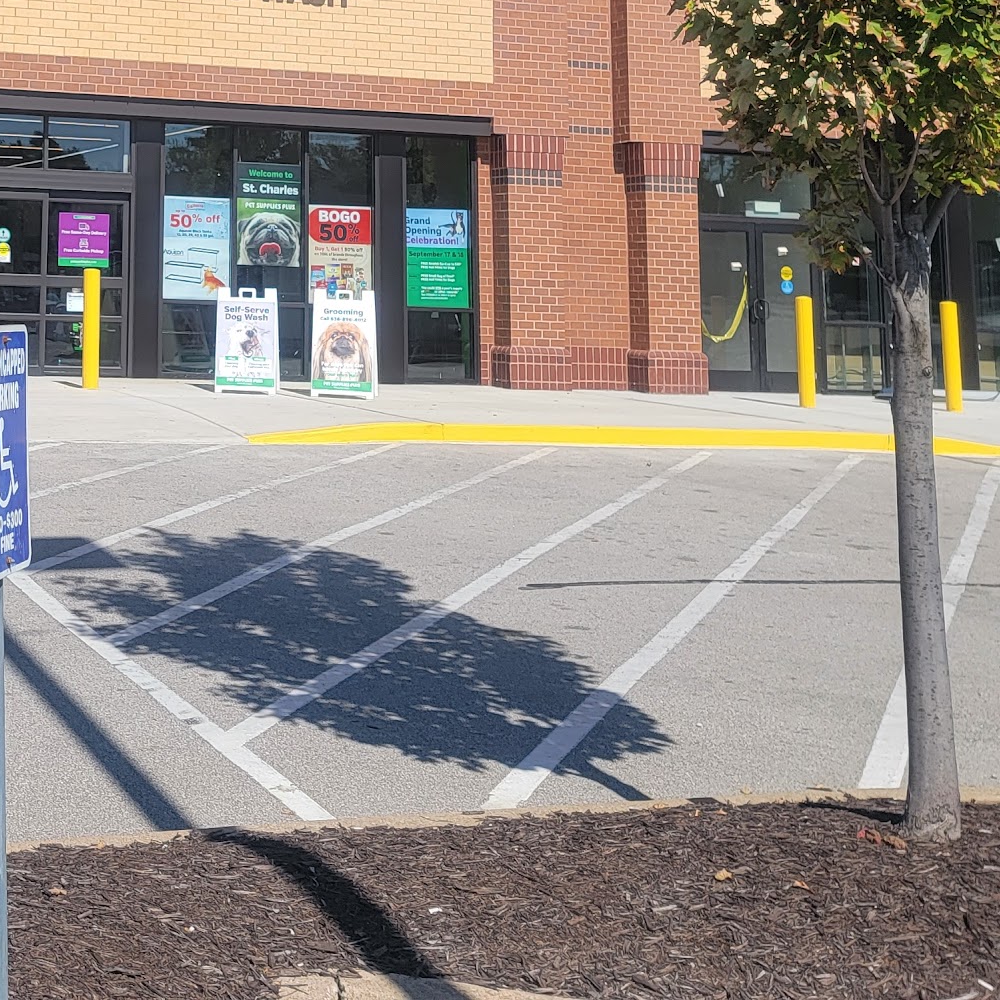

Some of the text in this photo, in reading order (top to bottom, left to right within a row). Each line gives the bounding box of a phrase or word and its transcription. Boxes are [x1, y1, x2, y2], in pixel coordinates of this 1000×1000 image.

[248, 168, 294, 179] Welcome to
[242, 182, 299, 196] St. Charles
[244, 201, 296, 211] PET SUPPLIES PLUS
[169, 213, 221, 229] 50% off
[318, 209, 361, 224] BOGO
[320, 223, 360, 242] 50%
[406, 226, 442, 237] Opening
[349, 235, 359, 243] off
[408, 250, 444, 259] September
[223, 305, 270, 314] Self-Serve
[323, 307, 364, 318] Grooming
[225, 312, 269, 322] Dog Wash
[0, 531, 15, 555] FINE
